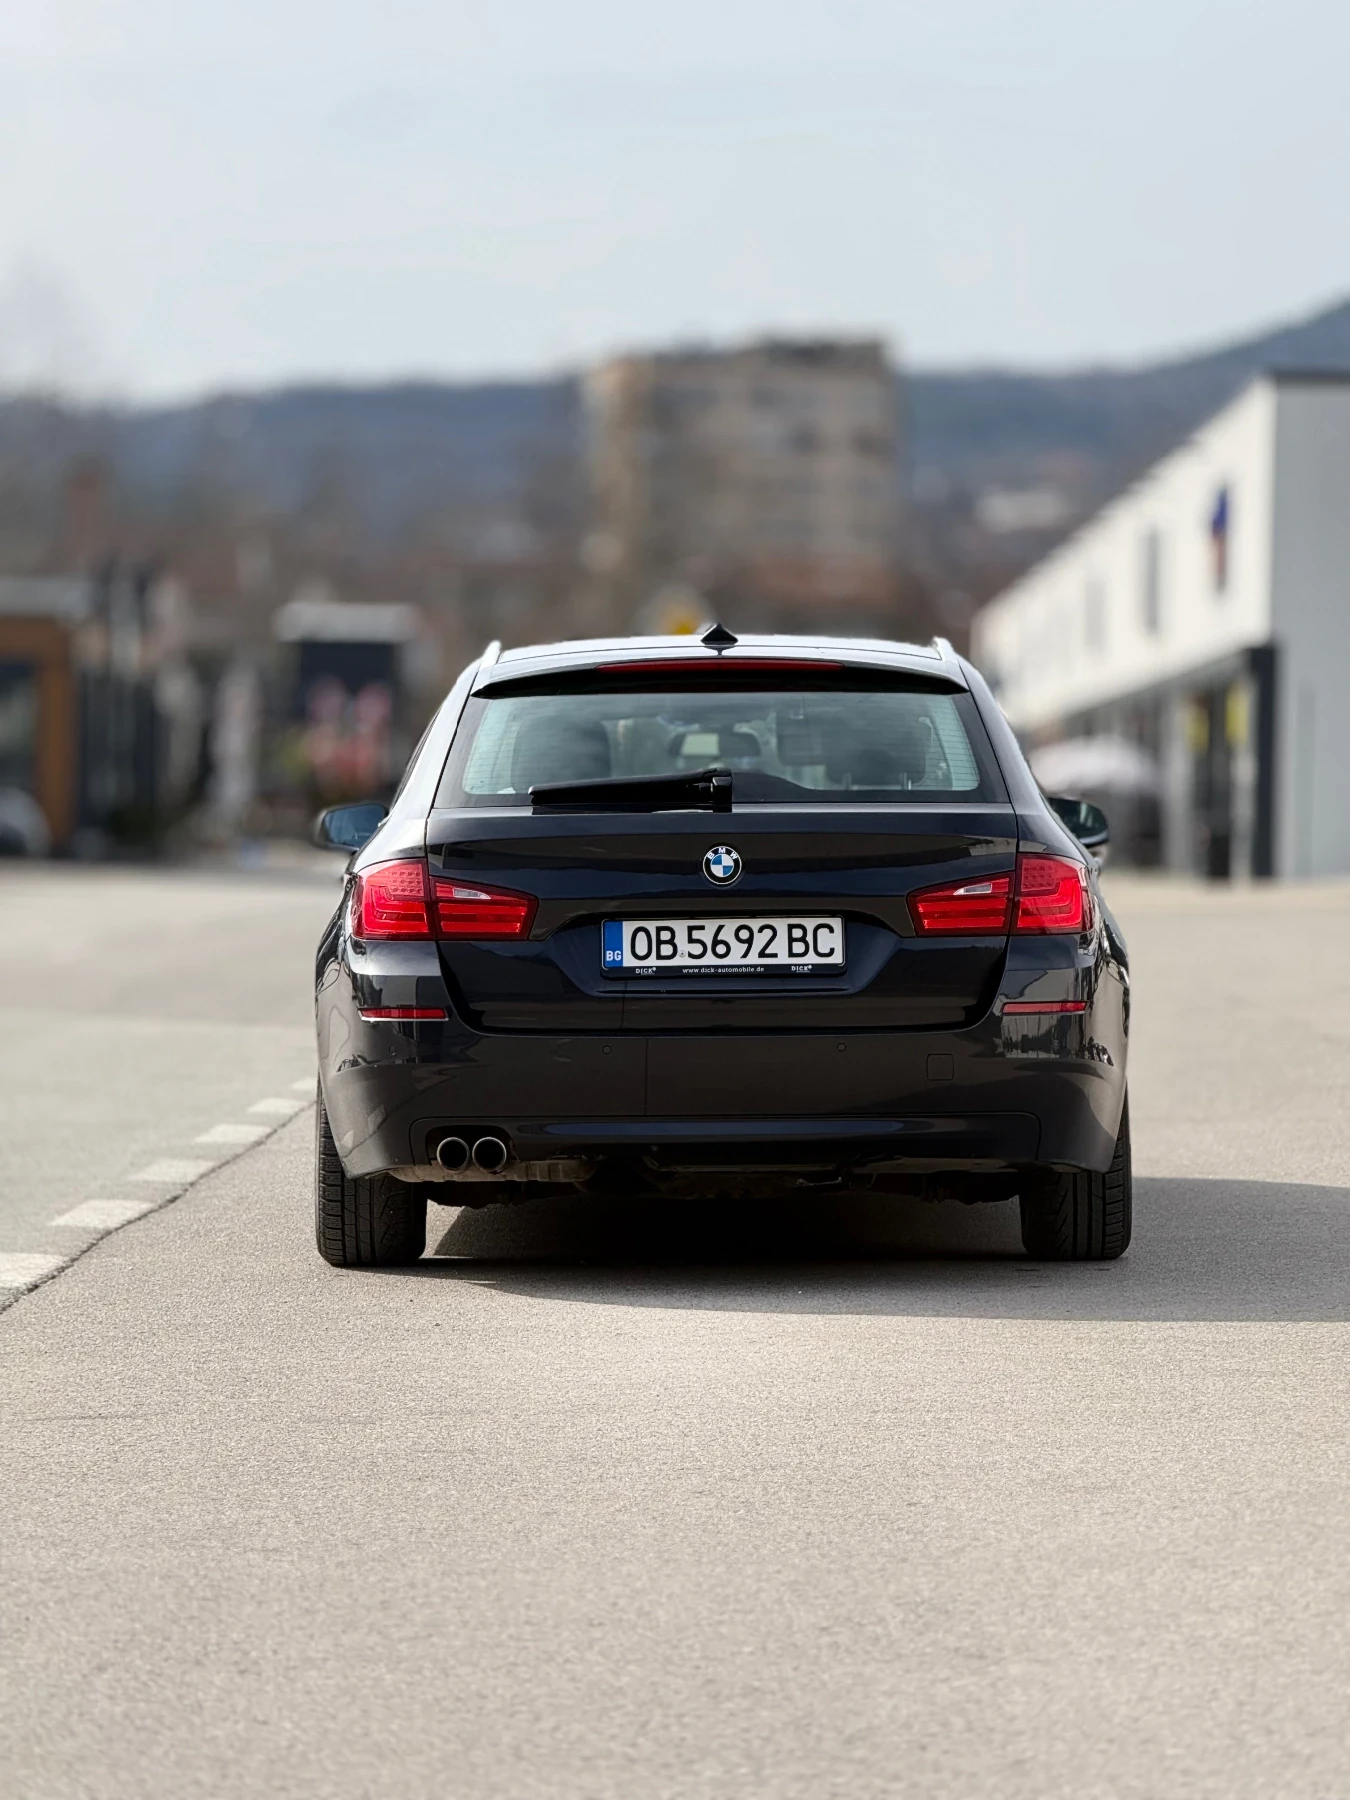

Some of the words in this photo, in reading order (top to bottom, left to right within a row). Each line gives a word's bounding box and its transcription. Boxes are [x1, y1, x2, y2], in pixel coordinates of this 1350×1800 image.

[706, 847, 738, 860] BMW
[630, 925, 678, 961] OB
[686, 924, 779, 960] 5692
[787, 923, 835, 959] BC
[606, 951, 622, 962] BG
[682, 966, 765, 974] www.dick-automobile.de
